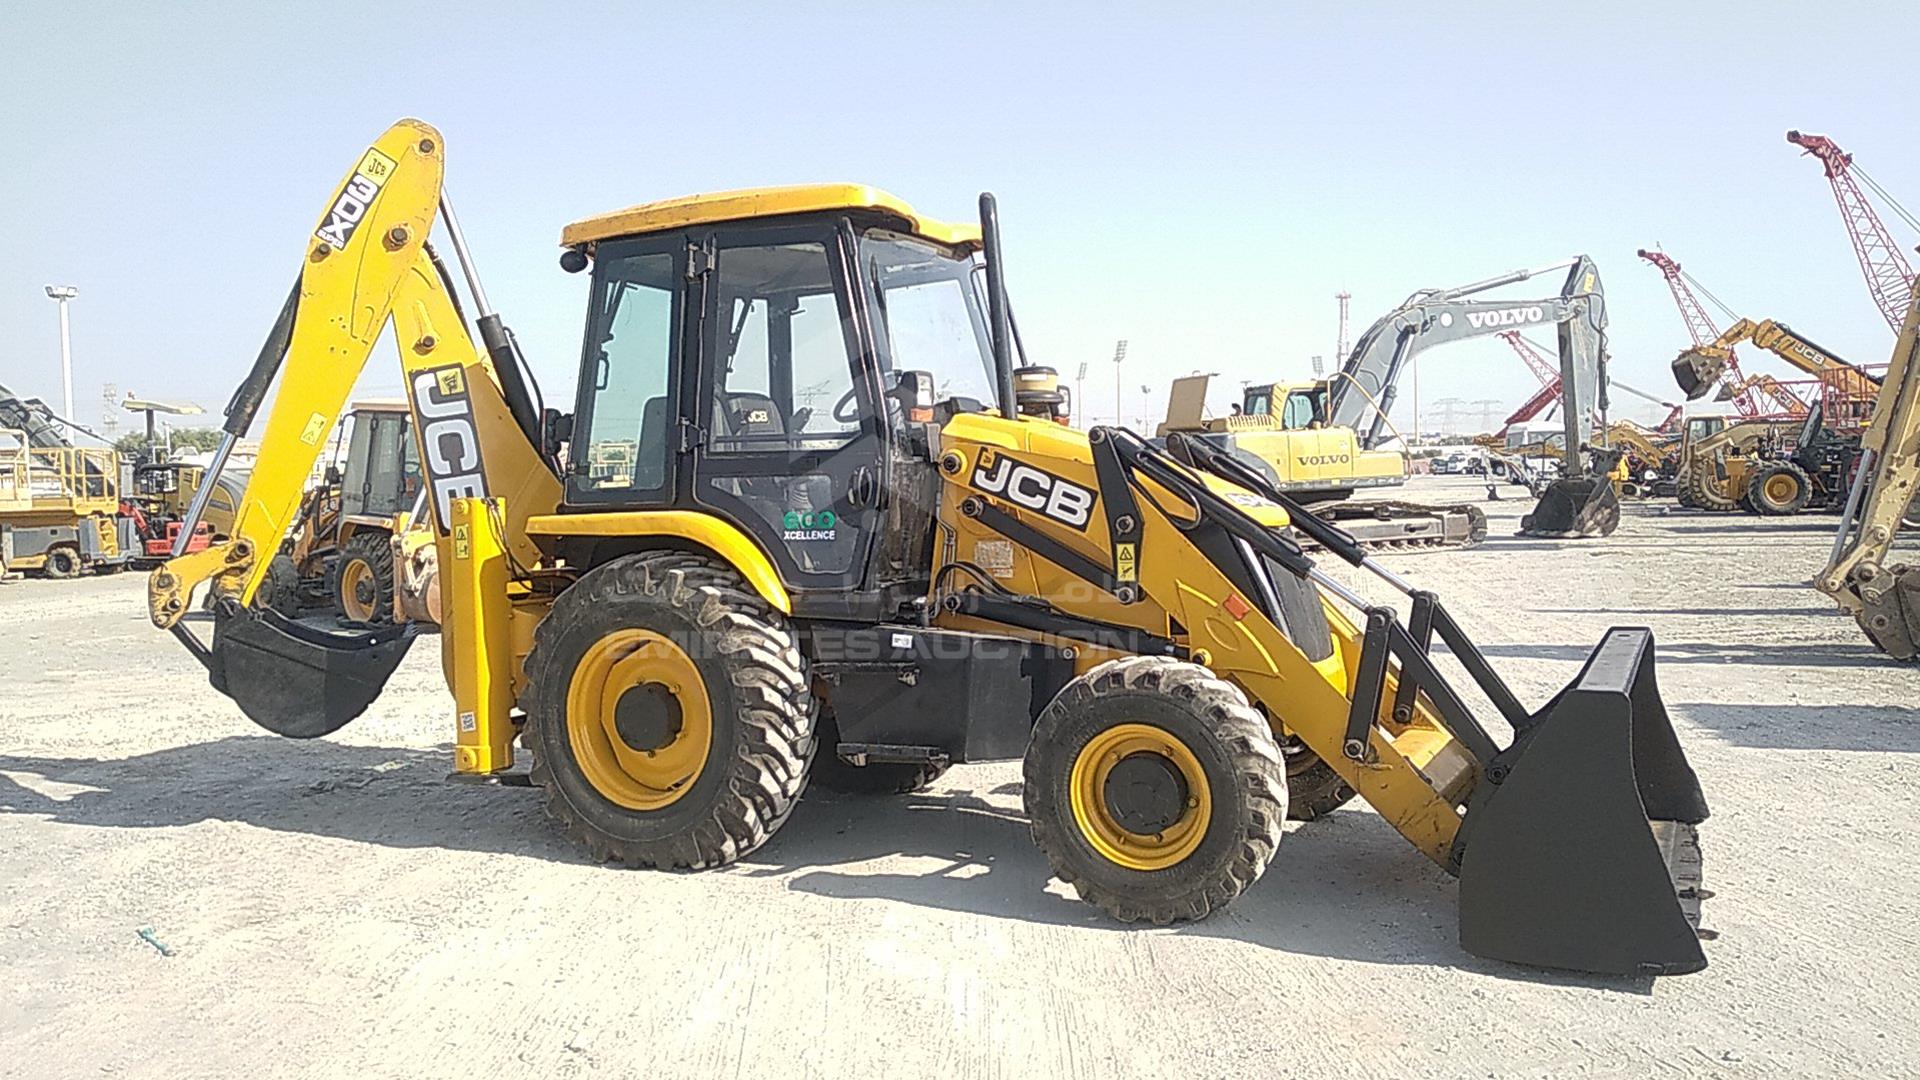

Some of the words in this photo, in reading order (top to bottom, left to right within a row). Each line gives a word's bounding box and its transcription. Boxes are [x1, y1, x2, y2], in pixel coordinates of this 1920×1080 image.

[368, 158, 386, 176] JCB
[1466, 306, 1543, 328] VOLVO
[1794, 343, 1825, 365] JCB
[747, 410, 768, 422] JCB
[1297, 454, 1349, 466] VOLVO
[975, 458, 1092, 526] JCB
[783, 530, 836, 540] XCELLENCE
